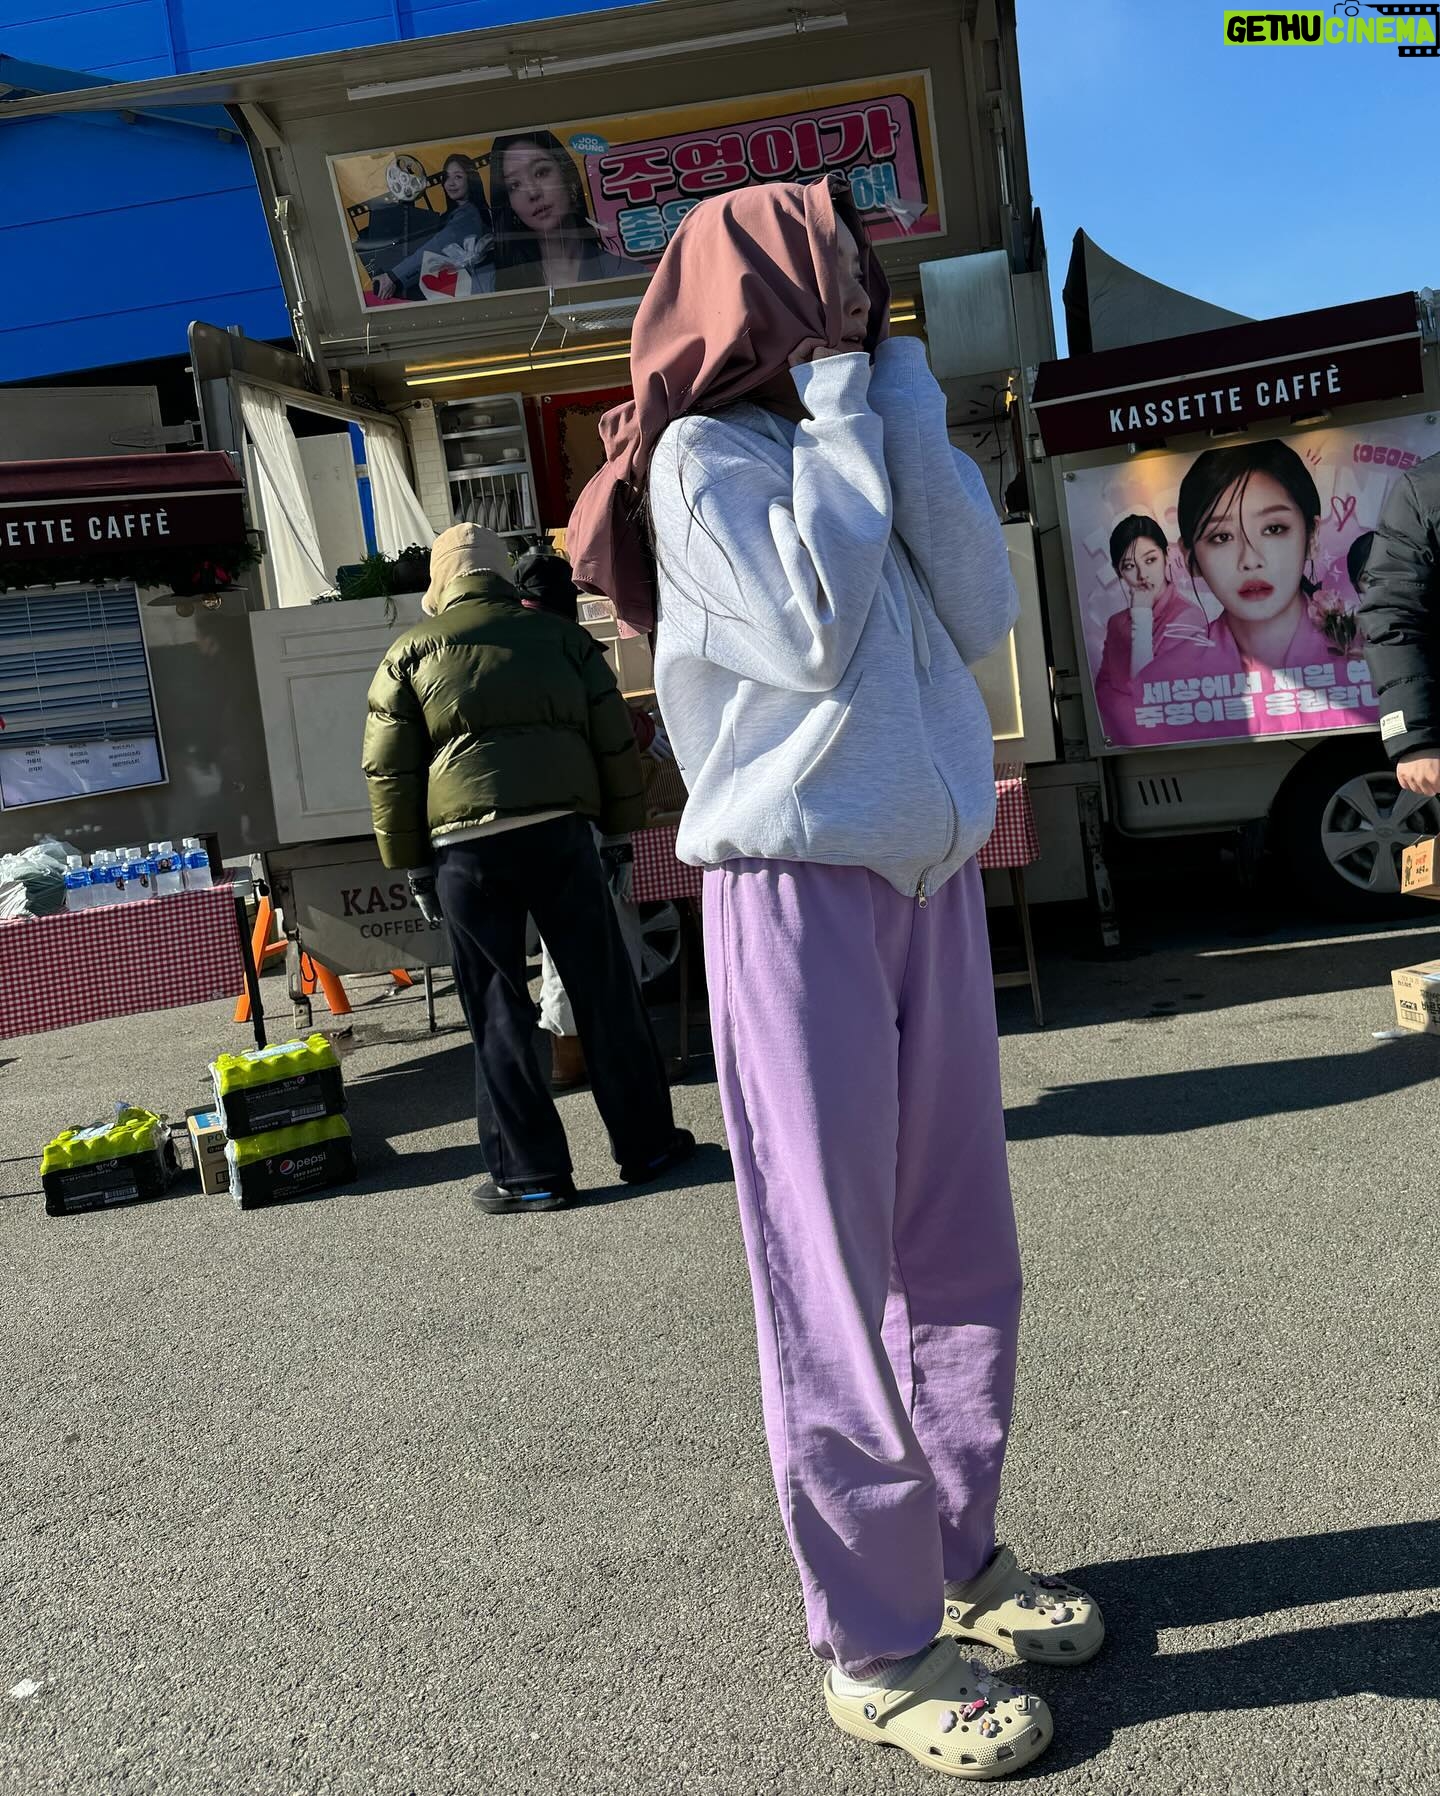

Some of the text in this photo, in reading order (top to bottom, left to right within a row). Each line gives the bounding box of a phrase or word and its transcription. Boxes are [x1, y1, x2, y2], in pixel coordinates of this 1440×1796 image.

[572, 141, 605, 153] YOUNG
[577, 136, 599, 145] JOO
[601, 105, 900, 203] 주영이가
[1109, 364, 1342, 433] KASSETTE CAFFÈ
[0, 508, 170, 546] ETTE CAFFÈ
[1142, 671, 1263, 705] 세상에서
[1271, 663, 1337, 691] 제일
[1135, 696, 1255, 728] 주영이를
[360, 918, 425, 939] COFFEE
[296, 1151, 327, 1170] pepsi
